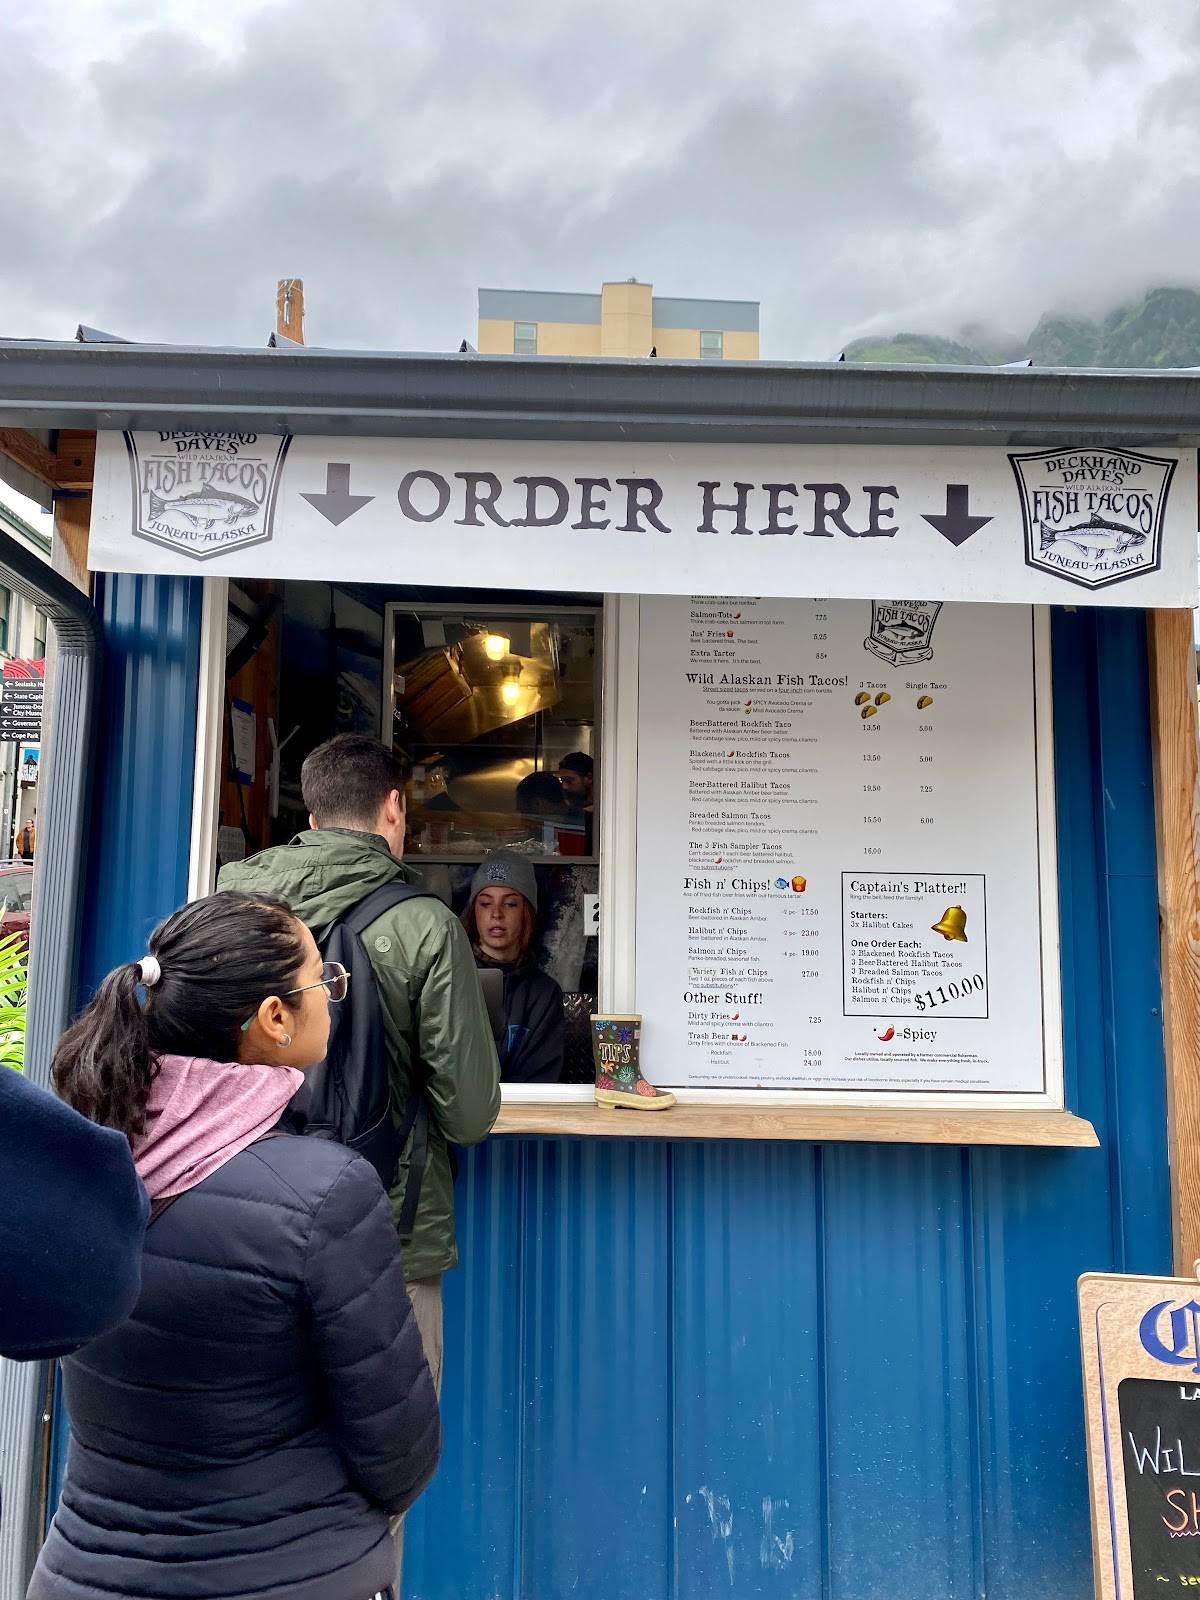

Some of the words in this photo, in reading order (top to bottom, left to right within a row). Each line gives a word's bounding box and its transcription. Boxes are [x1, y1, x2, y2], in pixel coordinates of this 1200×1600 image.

[175, 437, 239, 454] DAVE'S
[1044, 456, 1141, 475] DECKHAND
[143, 461, 191, 493] FISH
[198, 462, 268, 504] TACOS
[1062, 469, 1124, 485] DAVE'S
[398, 470, 672, 534] ORDER
[697, 481, 900, 537] HERE
[1032, 491, 1079, 523] FISH
[1085, 492, 1153, 533] TACOS
[1041, 552, 1144, 571] JUNEAU-ALASKA
[876, 608, 898, 623] FISH
[900, 610, 930, 632] TACOS
[686, 674, 713, 684] Wild
[719, 674, 772, 685] Alaskan
[777, 674, 804, 686] Fish
[809, 675, 848, 686] Tacos!
[730, 843, 760, 851] Sampler
[684, 878, 711, 889] Fish
[717, 878, 726, 890] n'
[732, 879, 770, 892] Chips!
[851, 881, 909, 894] Captain's
[914, 882, 966, 894] Platter!!
[684, 992, 720, 1004] Other
[725, 993, 762, 1004] Stuff!
[915, 974, 984, 1011] $110.00
[688, 1012, 708, 1020] Dirty
[599, 1043, 632, 1063] TIPS
